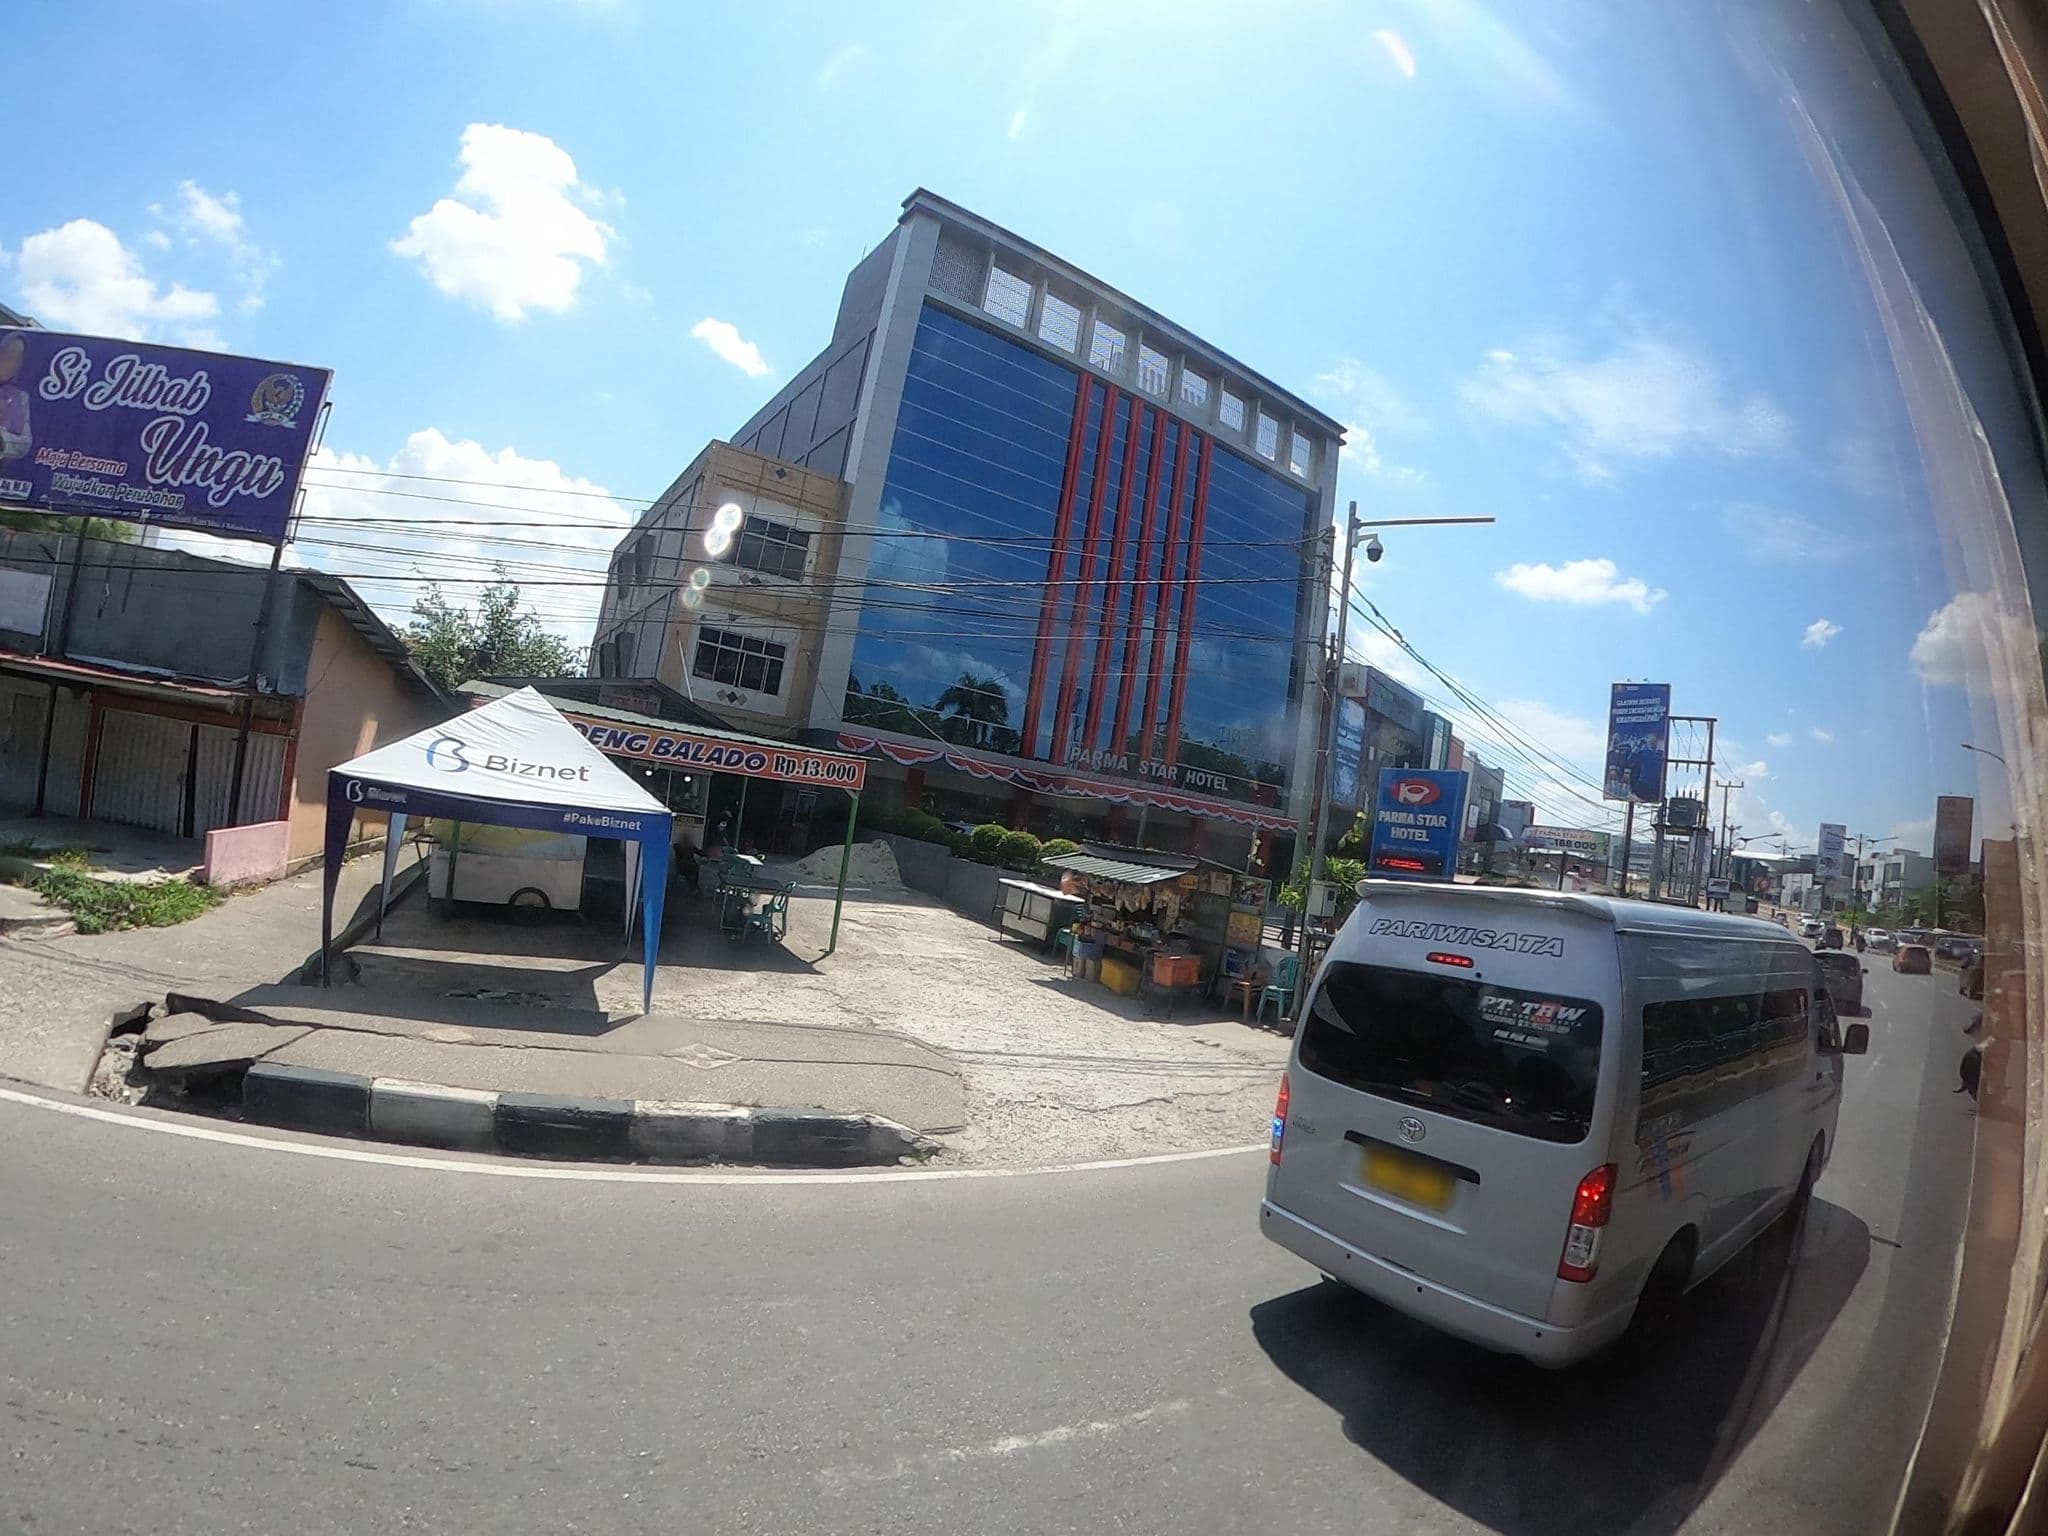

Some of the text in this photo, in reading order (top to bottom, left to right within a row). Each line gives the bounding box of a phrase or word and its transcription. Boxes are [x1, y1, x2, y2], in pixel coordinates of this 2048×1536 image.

[39, 347, 211, 415] Si Jilbab
[35, 447, 128, 476] Maju Bersama
[141, 415, 284, 507] Ungu
[485, 755, 591, 782] Biznet
[649, 738, 768, 773] BALADO
[772, 754, 857, 782] Rp.13.000
[1070, 748, 1229, 792] PARMA STAR HOTEL
[563, 813, 642, 831] #PakeBiznet
[1378, 810, 1447, 828] PARMA STAR
[1390, 826, 1430, 842] HOTEL
[1369, 918, 1564, 957] PARIWISATA
